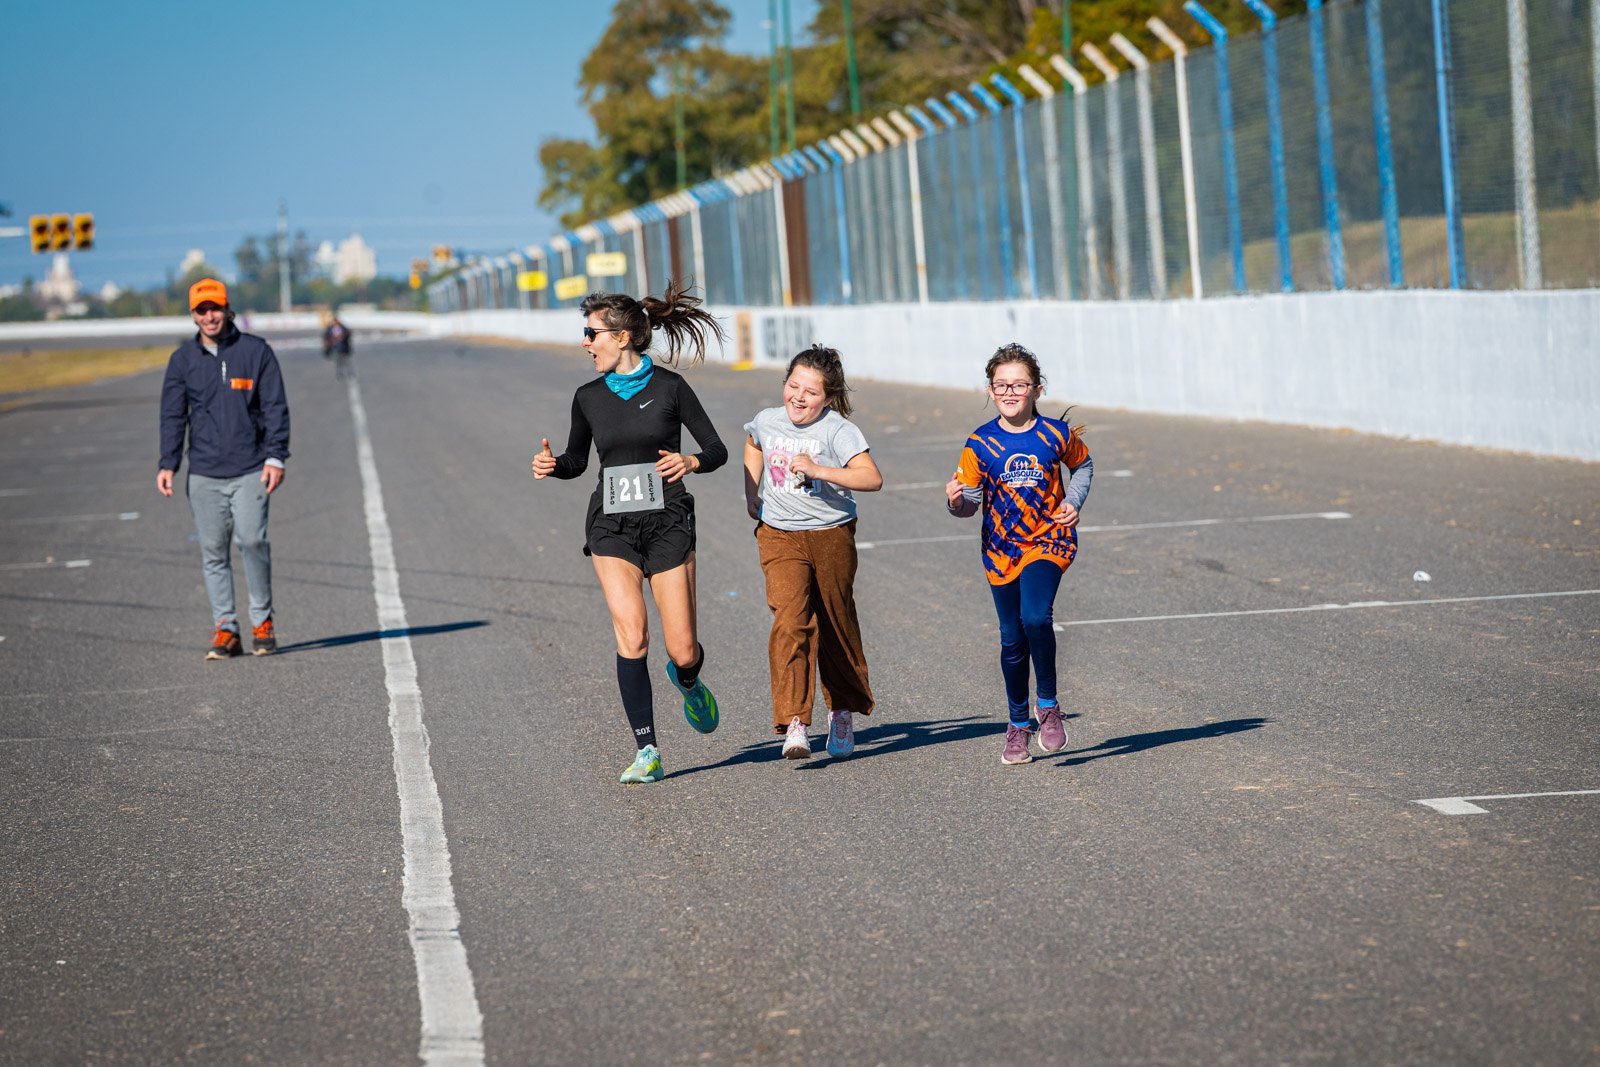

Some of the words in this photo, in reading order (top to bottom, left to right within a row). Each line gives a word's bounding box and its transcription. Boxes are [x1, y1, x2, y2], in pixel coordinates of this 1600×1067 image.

[1028, 456, 1037, 468] 2
[1001, 470, 1042, 481] EGUSQUIZA
[618, 475, 644, 502] 21
[647, 473, 655, 502] EXACTO
[635, 726, 651, 736] SOX
